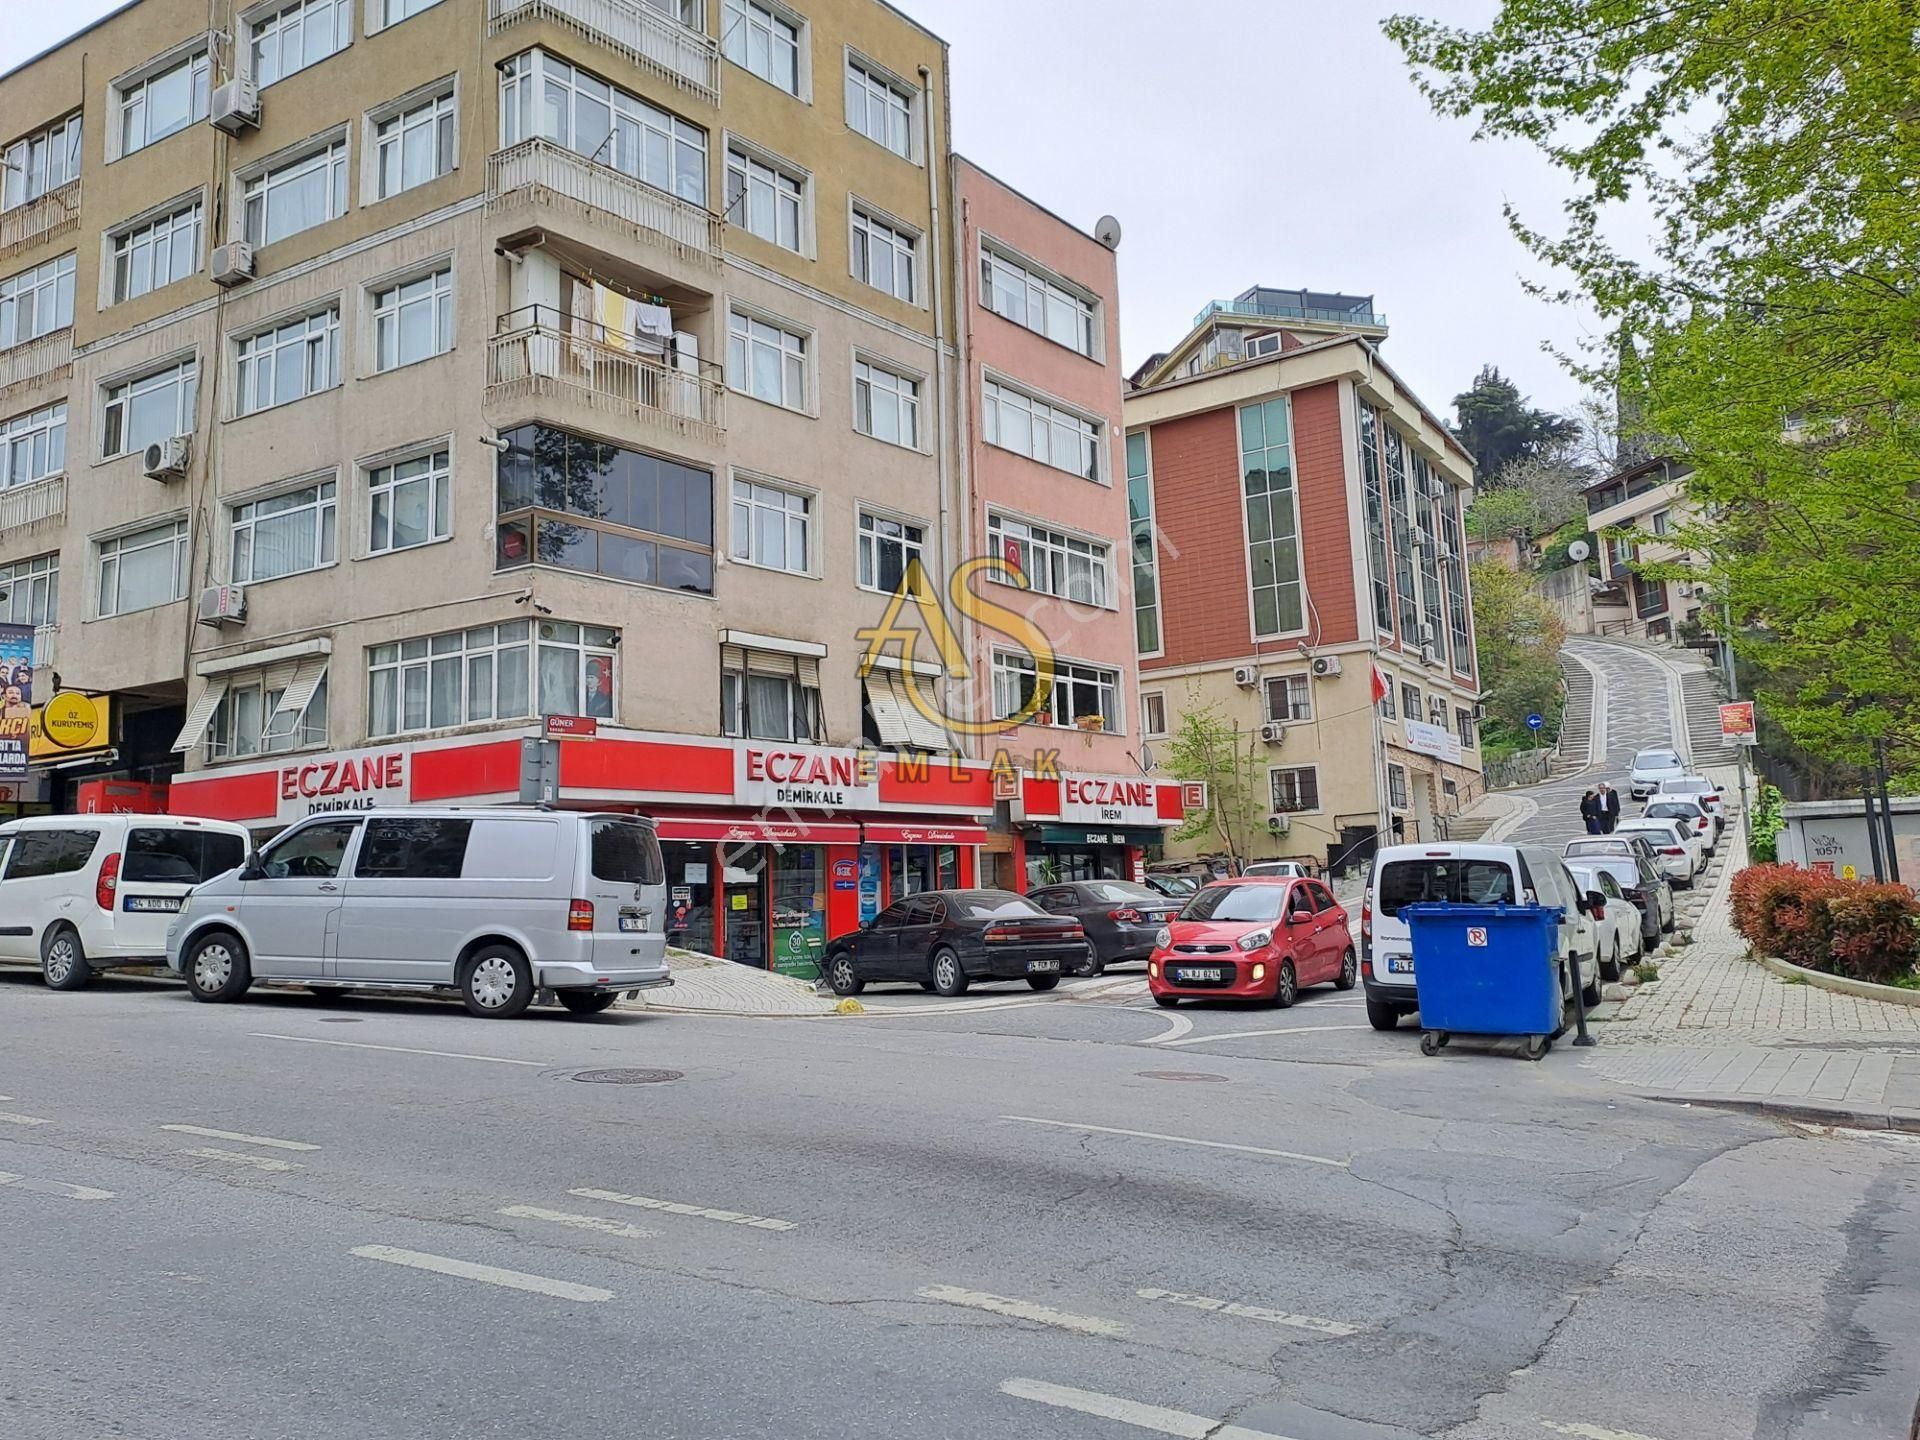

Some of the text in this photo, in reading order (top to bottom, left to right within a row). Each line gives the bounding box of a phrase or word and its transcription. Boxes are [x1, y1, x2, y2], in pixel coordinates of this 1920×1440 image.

[68, 709, 78, 719] ÖZ
[51, 719, 94, 730] KURUYEMİŞ
[549, 717, 574, 727] GÜNER
[747, 749, 869, 787] ECZANE
[281, 752, 403, 800] ECZANE
[777, 786, 843, 805] DEMİRKALE
[1065, 778, 1154, 807] ECZANE
[1188, 787, 1201, 802] E
[1101, 809, 1122, 820] İREM
[1086, 832, 1126, 844] ECZANE İREM
[1815, 846, 1844, 856] 10571
[792, 937, 801, 947] 30
[1395, 962, 1405, 971] 34
